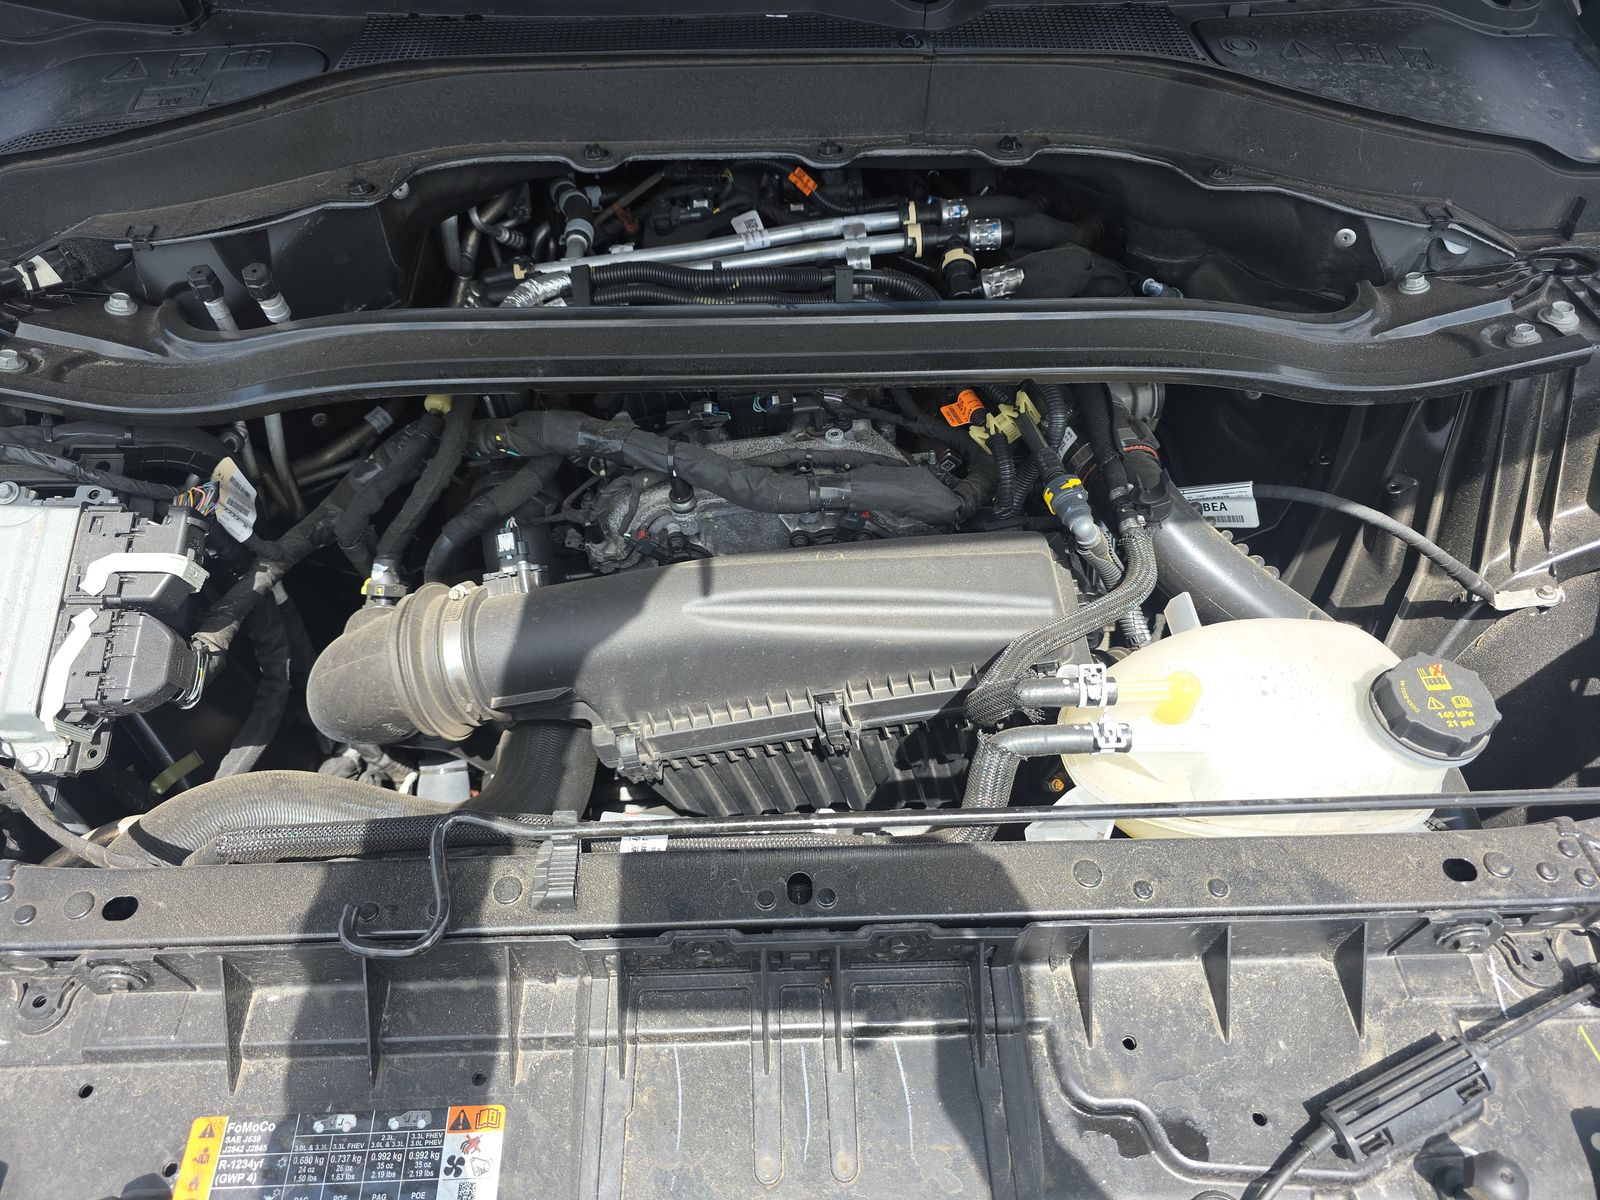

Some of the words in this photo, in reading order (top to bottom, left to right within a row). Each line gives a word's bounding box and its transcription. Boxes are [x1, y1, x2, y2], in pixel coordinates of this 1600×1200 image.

[1203, 502, 1227, 511] BEA
[1446, 720, 1458, 728] 21
[1461, 719, 1475, 728] psi
[227, 1121, 276, 1134] FoMoCo
[331, 1155, 351, 1163] 0.737
[352, 1154, 362, 1164] kg
[371, 1152, 391, 1160] 0.992
[393, 1152, 402, 1161] kg
[409, 1151, 429, 1160] 0.992
[430, 1151, 440, 1160] kg
[219, 1159, 264, 1171] R-1234yf
[293, 1156, 313, 1164] 0.680
[315, 1156, 324, 1165] kg
[215, 1173, 245, 1186] (GWP
[247, 1172, 257, 1184] 4)
